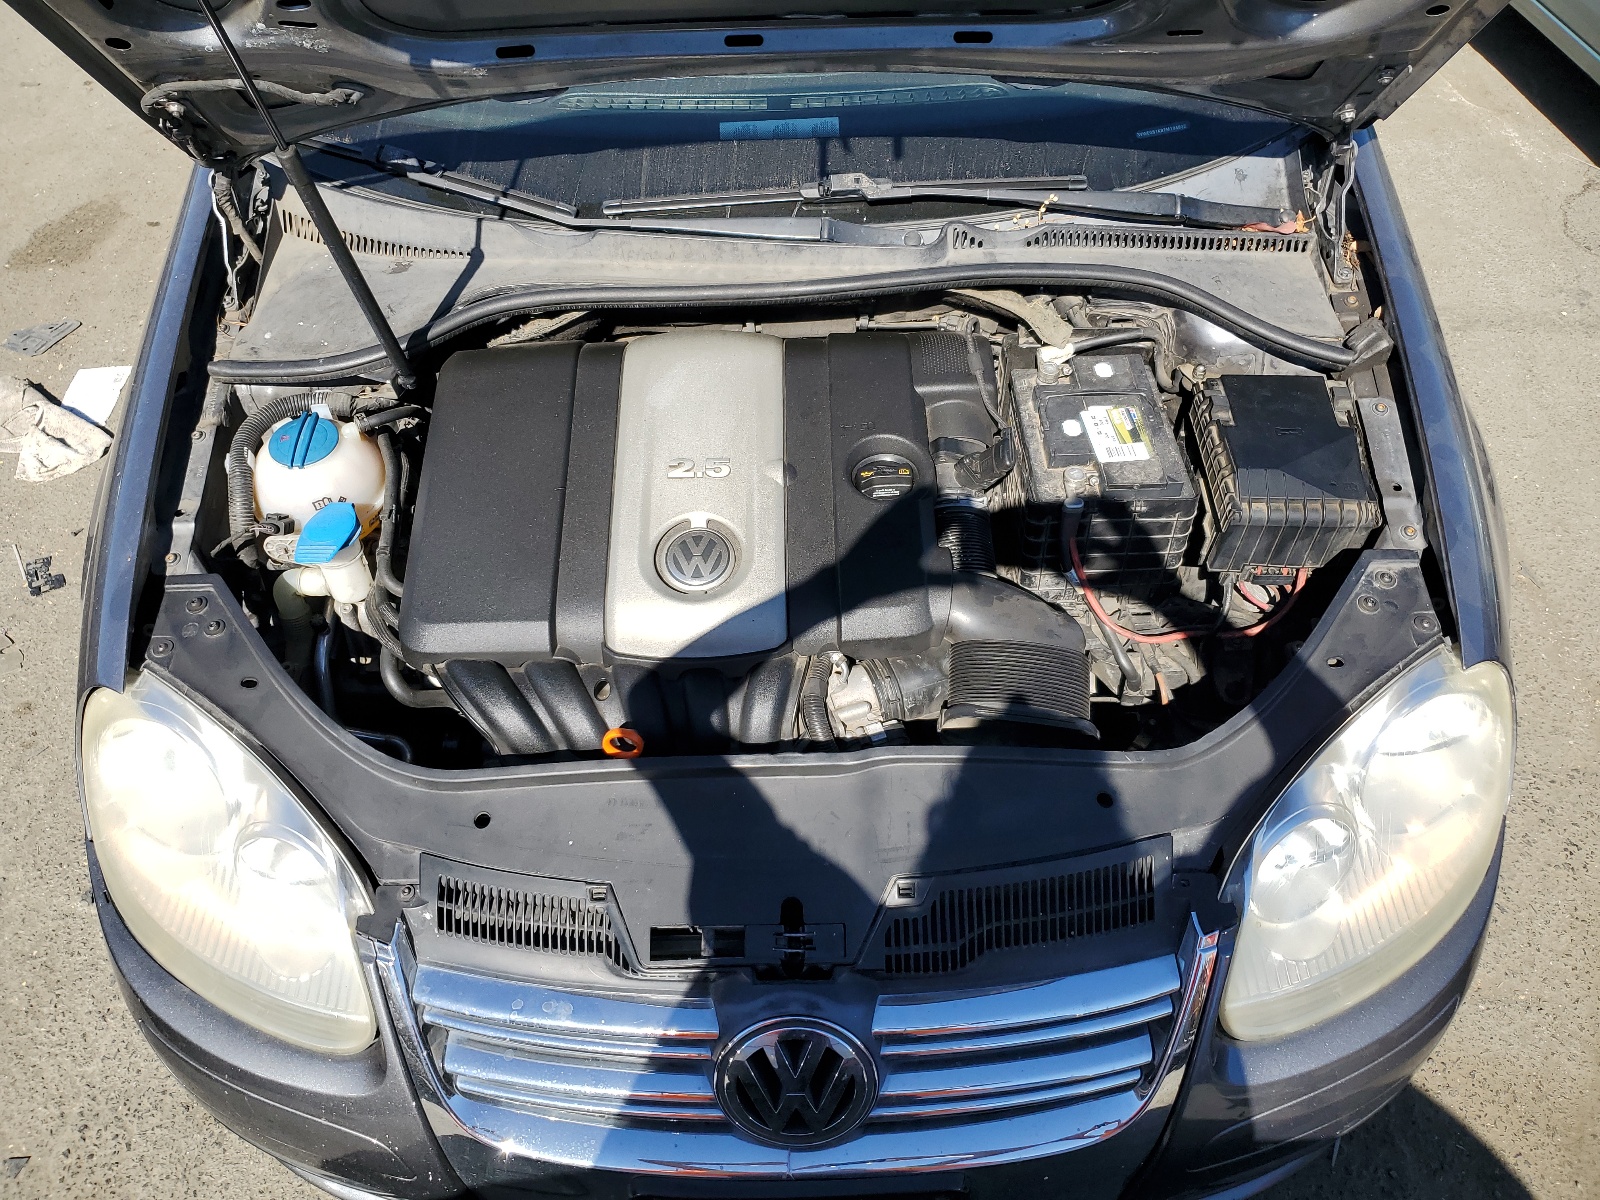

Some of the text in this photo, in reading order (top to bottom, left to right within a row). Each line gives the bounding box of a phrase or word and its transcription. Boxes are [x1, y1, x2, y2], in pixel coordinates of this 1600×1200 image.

[667, 457, 731, 478] 2.5
[668, 531, 728, 583] VW
[723, 1023, 869, 1143] VW
